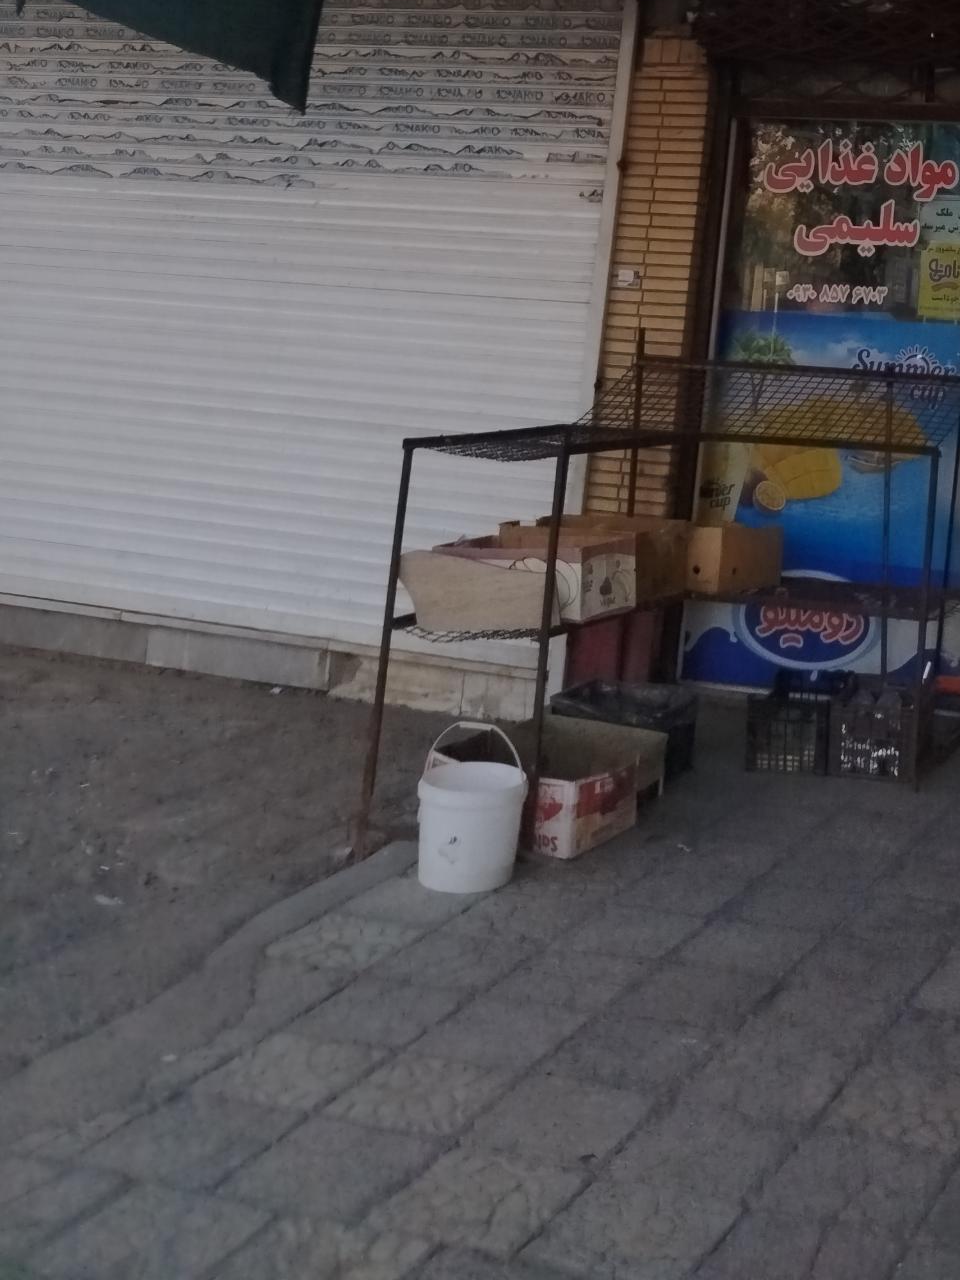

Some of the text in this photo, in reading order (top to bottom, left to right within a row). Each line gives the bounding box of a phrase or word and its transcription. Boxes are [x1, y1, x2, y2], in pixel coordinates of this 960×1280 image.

[763, 138, 959, 201] مواد غذایی
[794, 199, 921, 257] سلیمی
